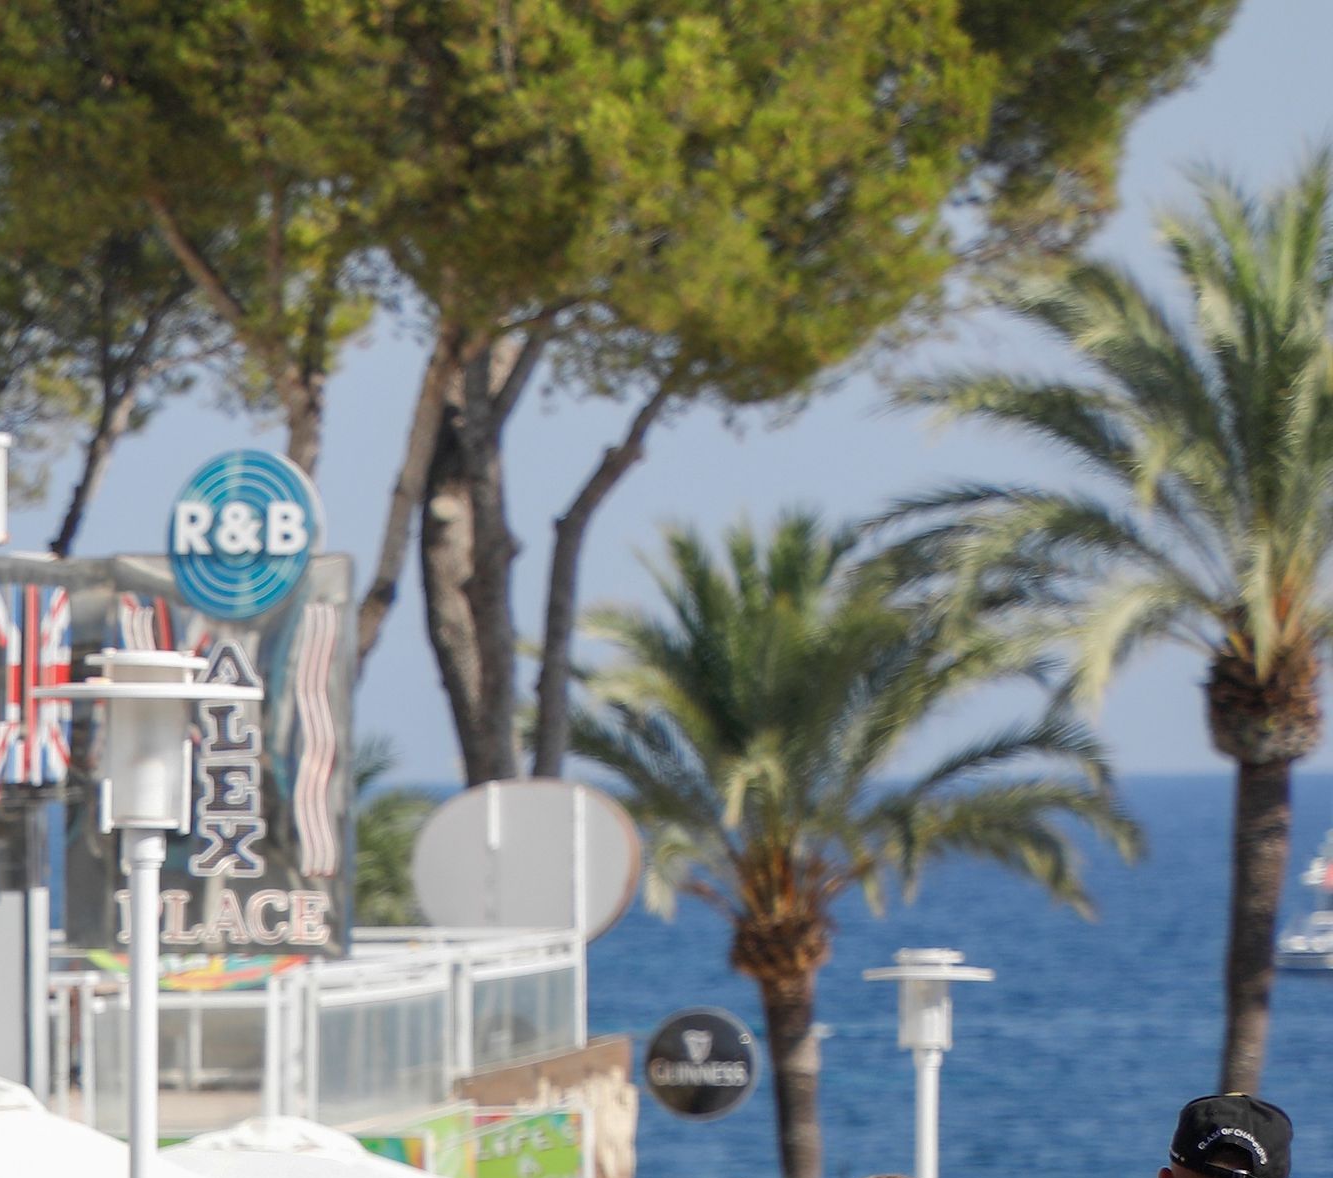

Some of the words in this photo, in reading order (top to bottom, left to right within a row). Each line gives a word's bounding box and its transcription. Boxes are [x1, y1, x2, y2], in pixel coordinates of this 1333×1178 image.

[174, 501, 309, 556] R&B
[189, 639, 266, 878] ALEX
[650, 1058, 749, 1088] GUINNESS
[1221, 1127, 1234, 1136] OF
[1233, 1128, 1268, 1165] CHAMPIONS
